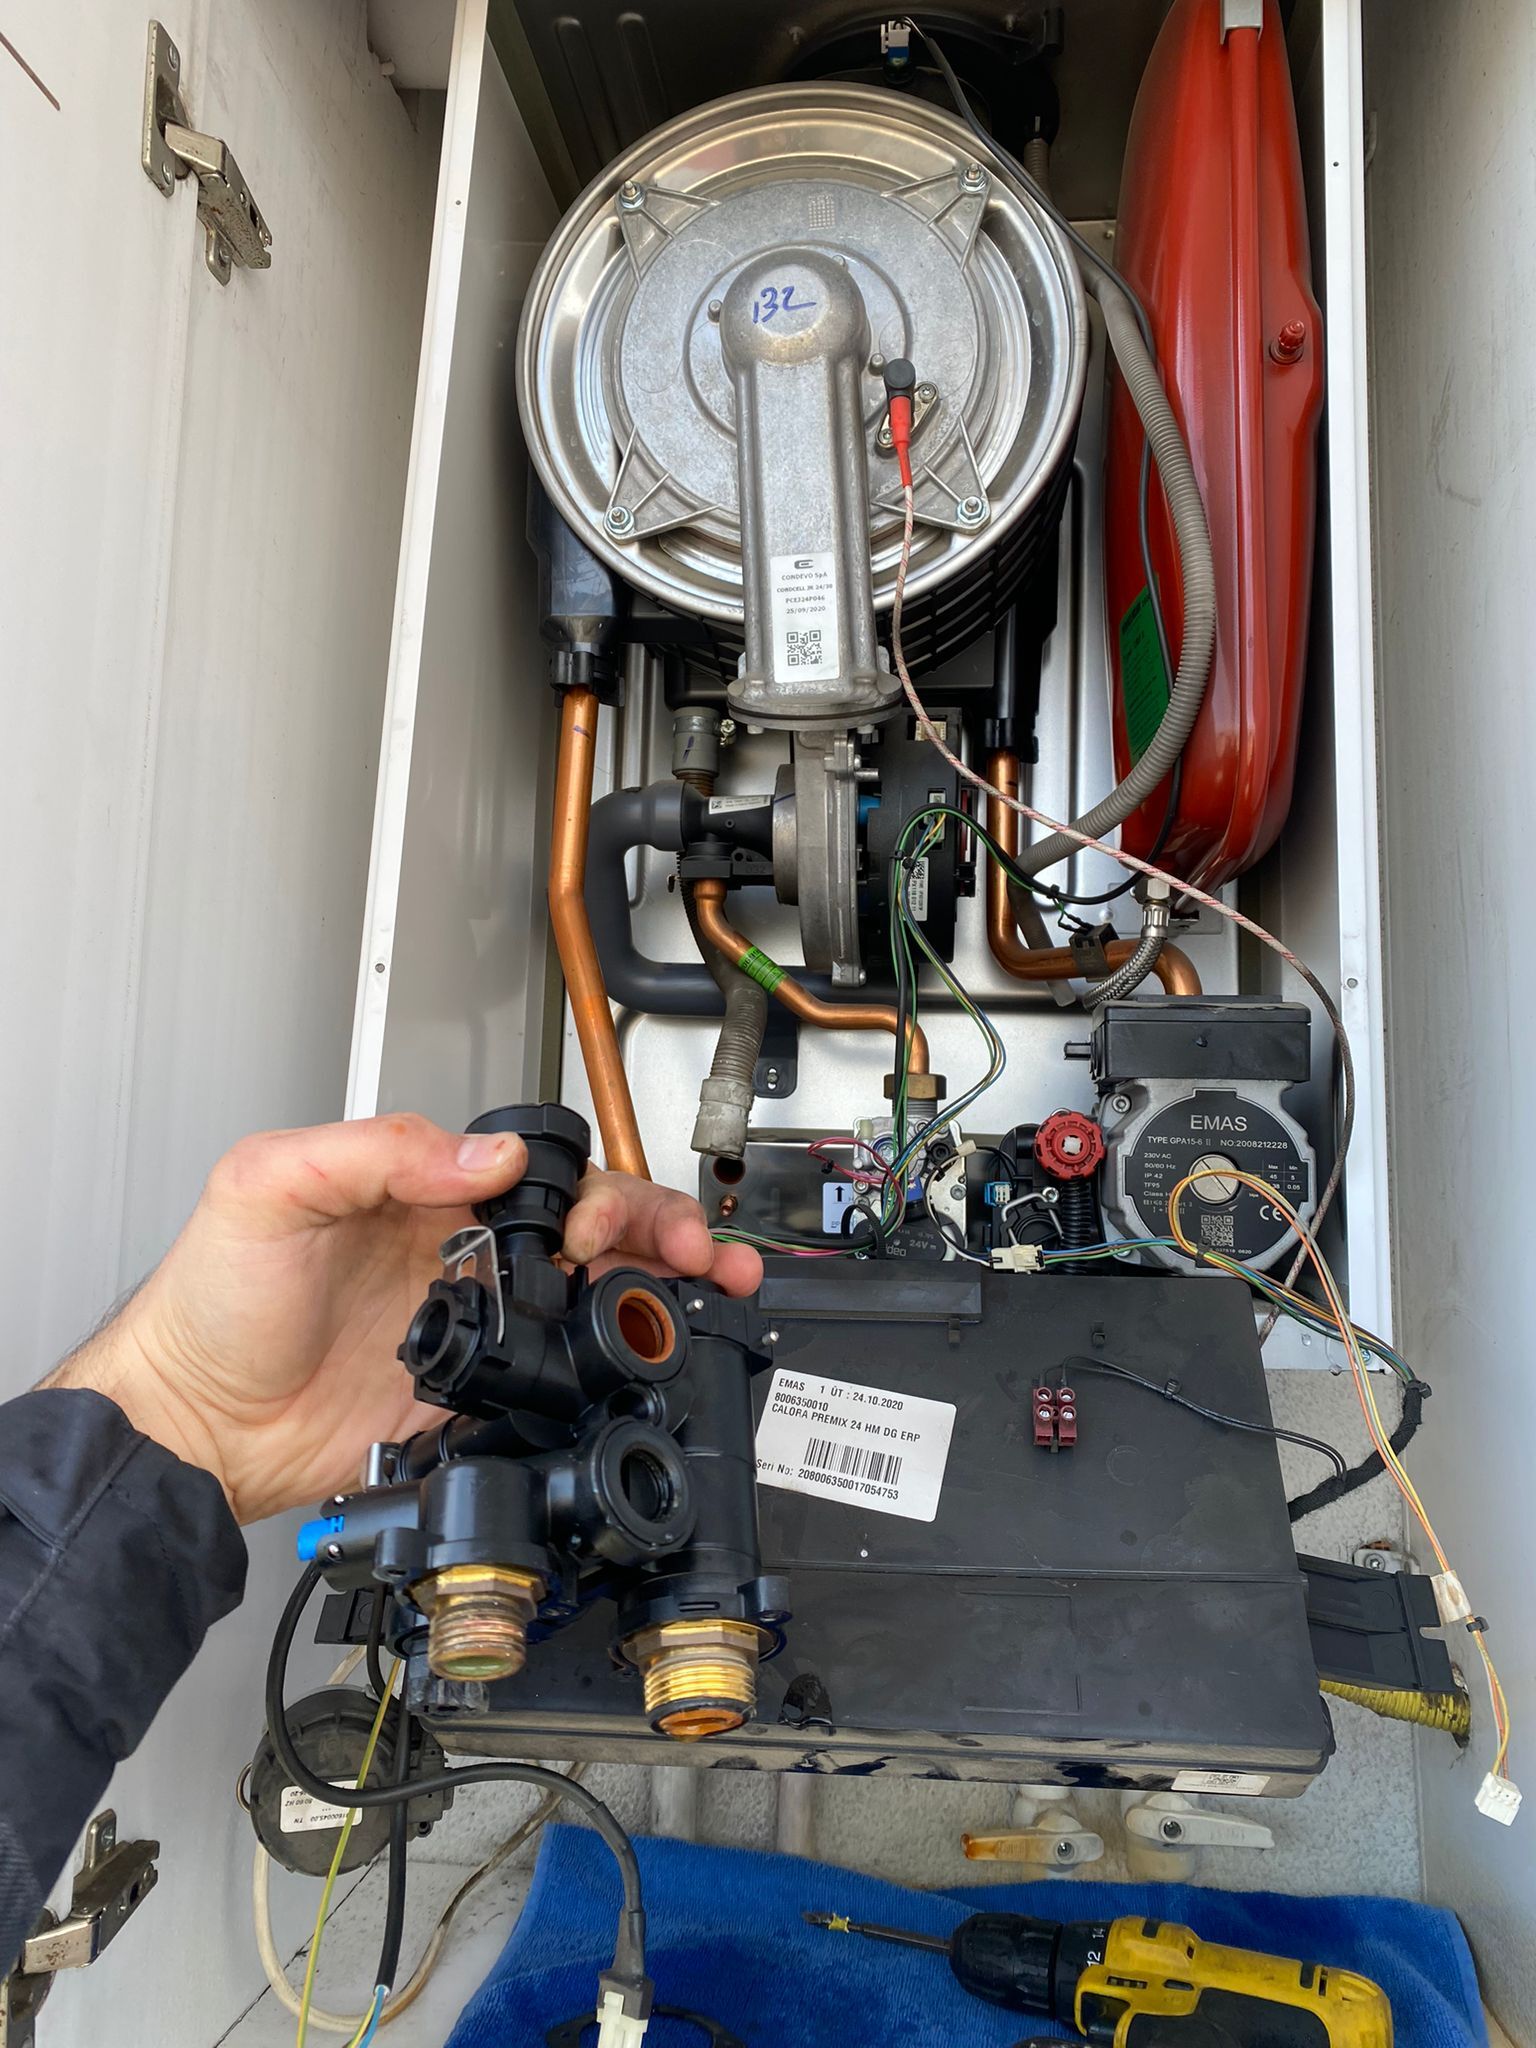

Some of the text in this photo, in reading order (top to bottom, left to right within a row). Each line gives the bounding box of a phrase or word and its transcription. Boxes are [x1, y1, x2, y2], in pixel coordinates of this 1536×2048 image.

[753, 286, 817, 323] 132
[786, 605, 826, 614] 25/09/2020
[1190, 1114, 1248, 1132] EMAS
[1147, 1135, 1168, 1145] TYPE
[1169, 1137, 1203, 1147] GPA15-6
[774, 1392, 829, 1412] 8006350010
[779, 1378, 806, 1391] EMAS
[820, 1385, 826, 1394] 1
[853, 1391, 904, 1411] 24.10.2020
[771, 1403, 921, 1443] CALORA PREMIX 24 HM DG ERP
[756, 1458, 774, 1472] Seri
[798, 1468, 899, 1500] 208006350017054753
[1087, 1951, 1101, 1967] 12
